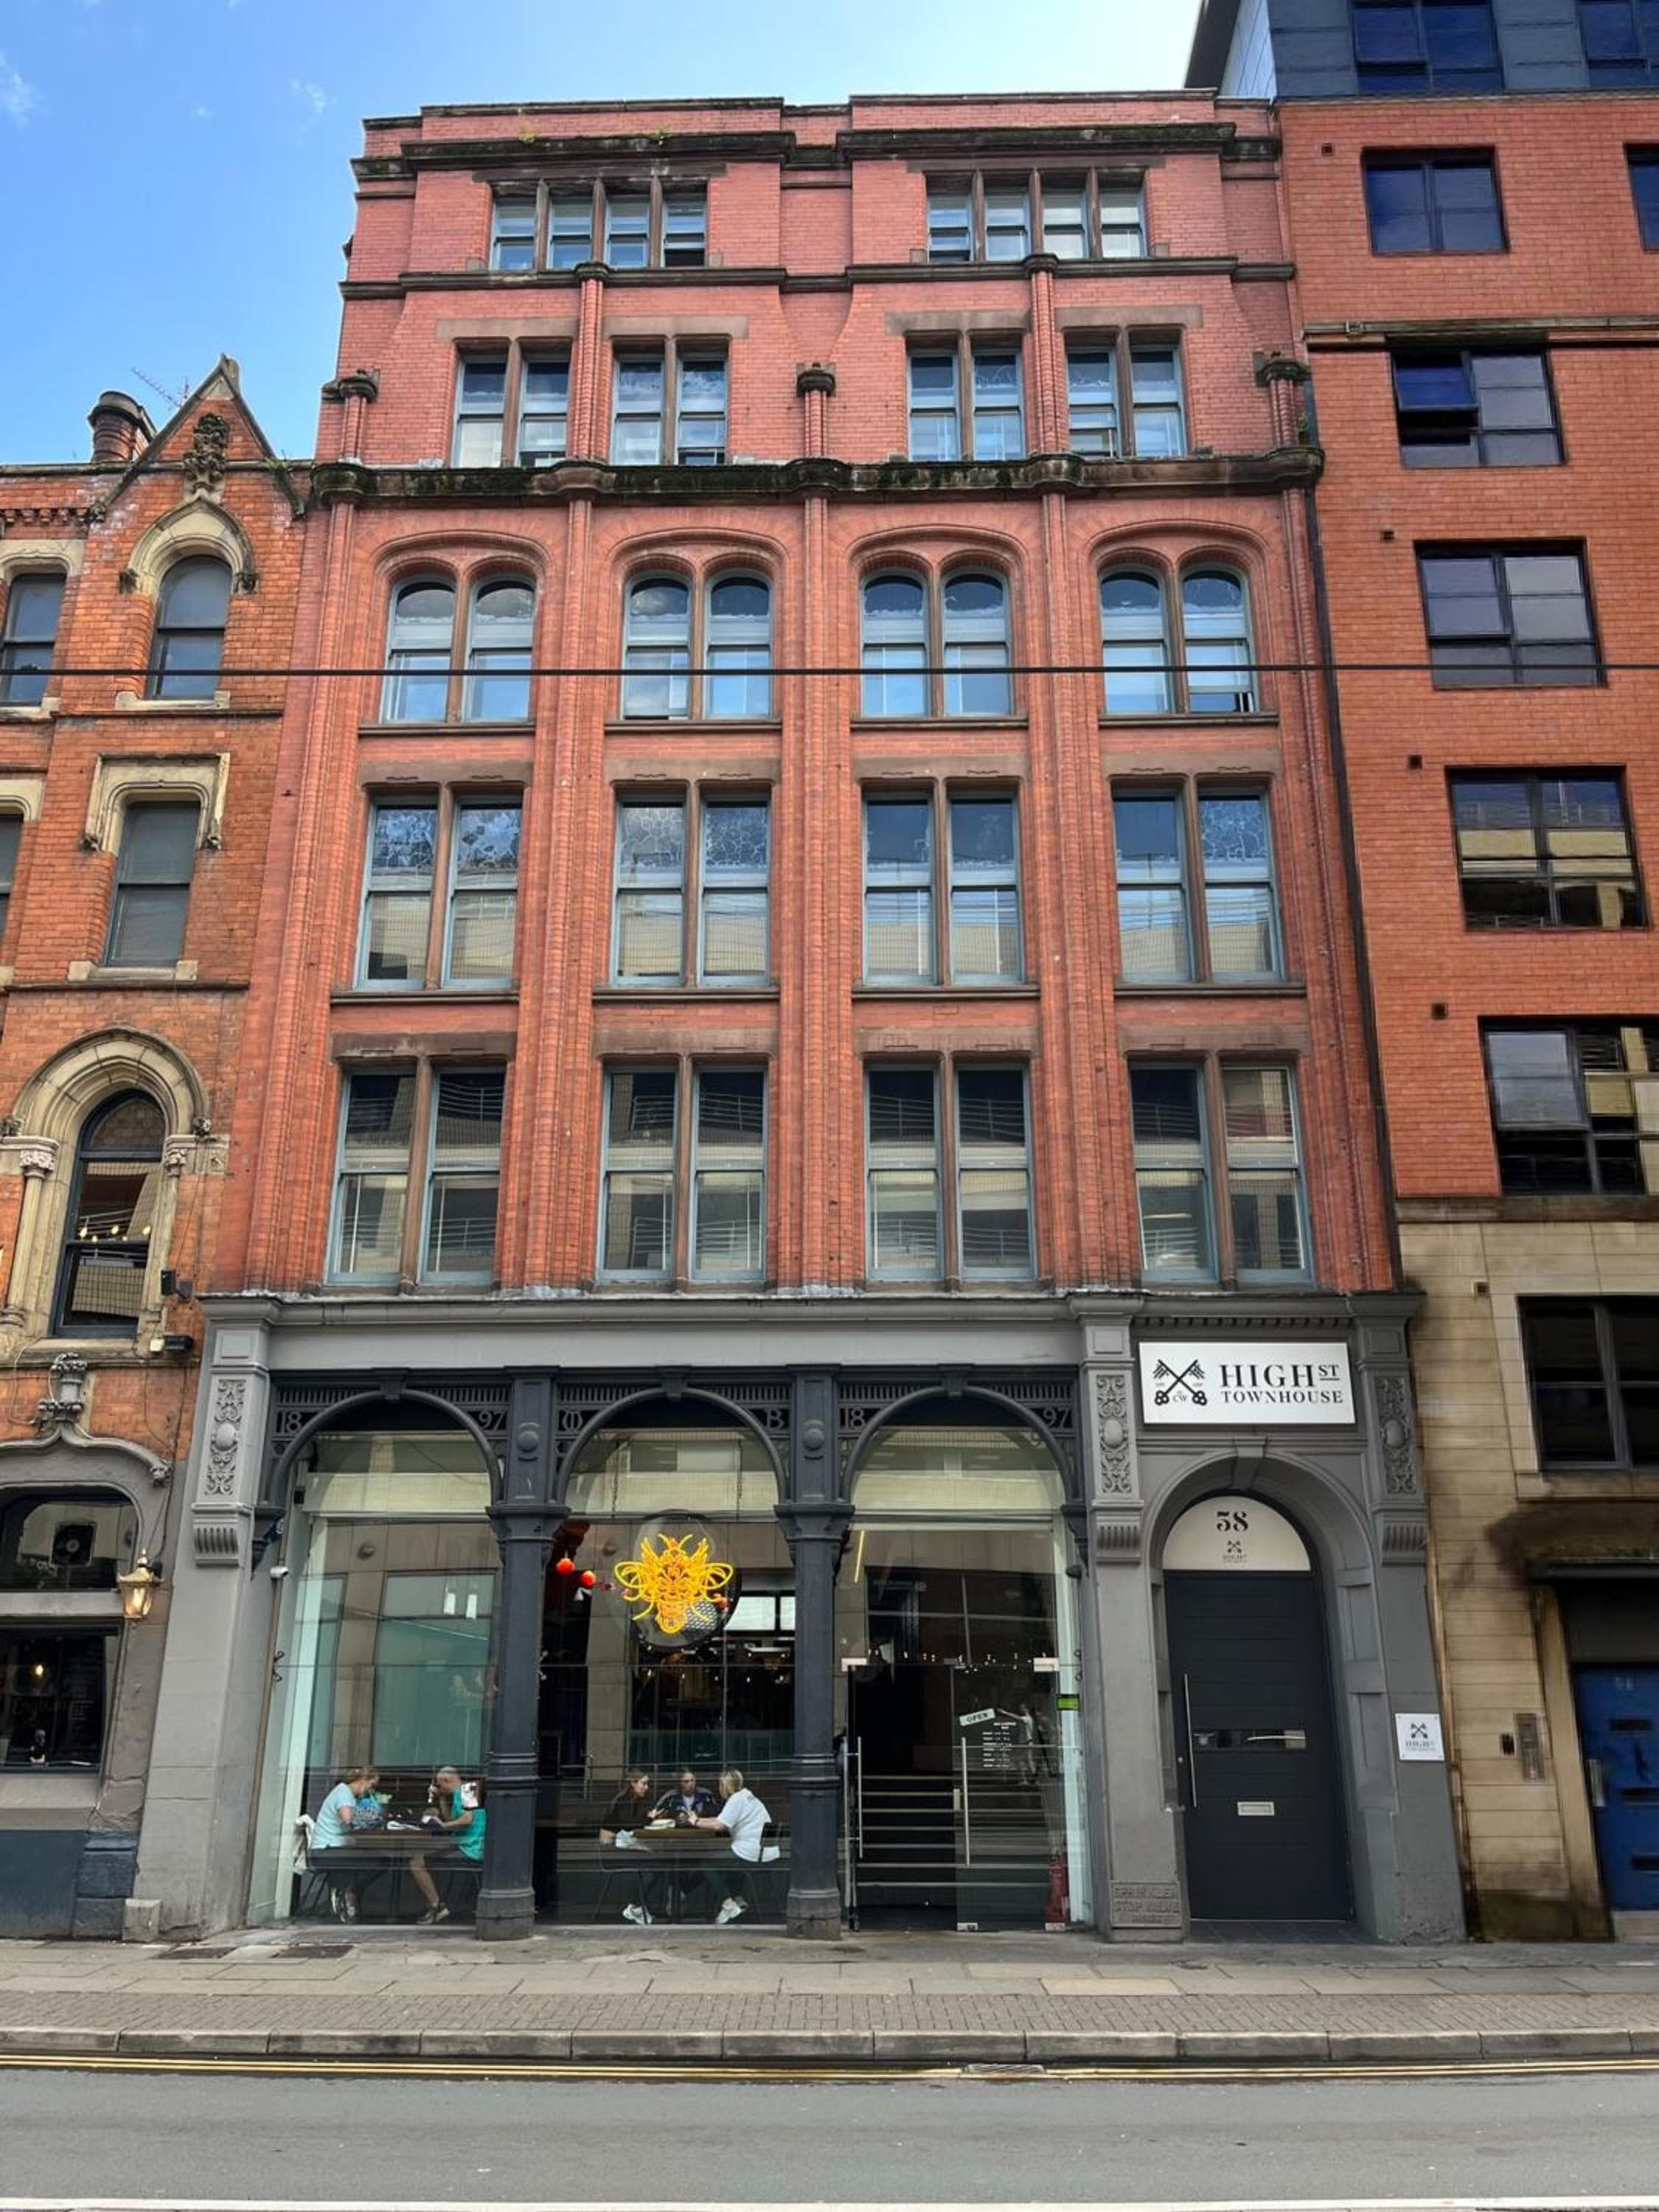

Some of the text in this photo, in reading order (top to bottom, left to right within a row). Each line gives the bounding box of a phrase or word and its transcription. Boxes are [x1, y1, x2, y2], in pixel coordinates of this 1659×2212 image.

[1220, 1364, 1340, 1388] HIGH ST
[1221, 1391, 1343, 1404] TOWNHOUSE
[1217, 1511, 1248, 1532] 58
